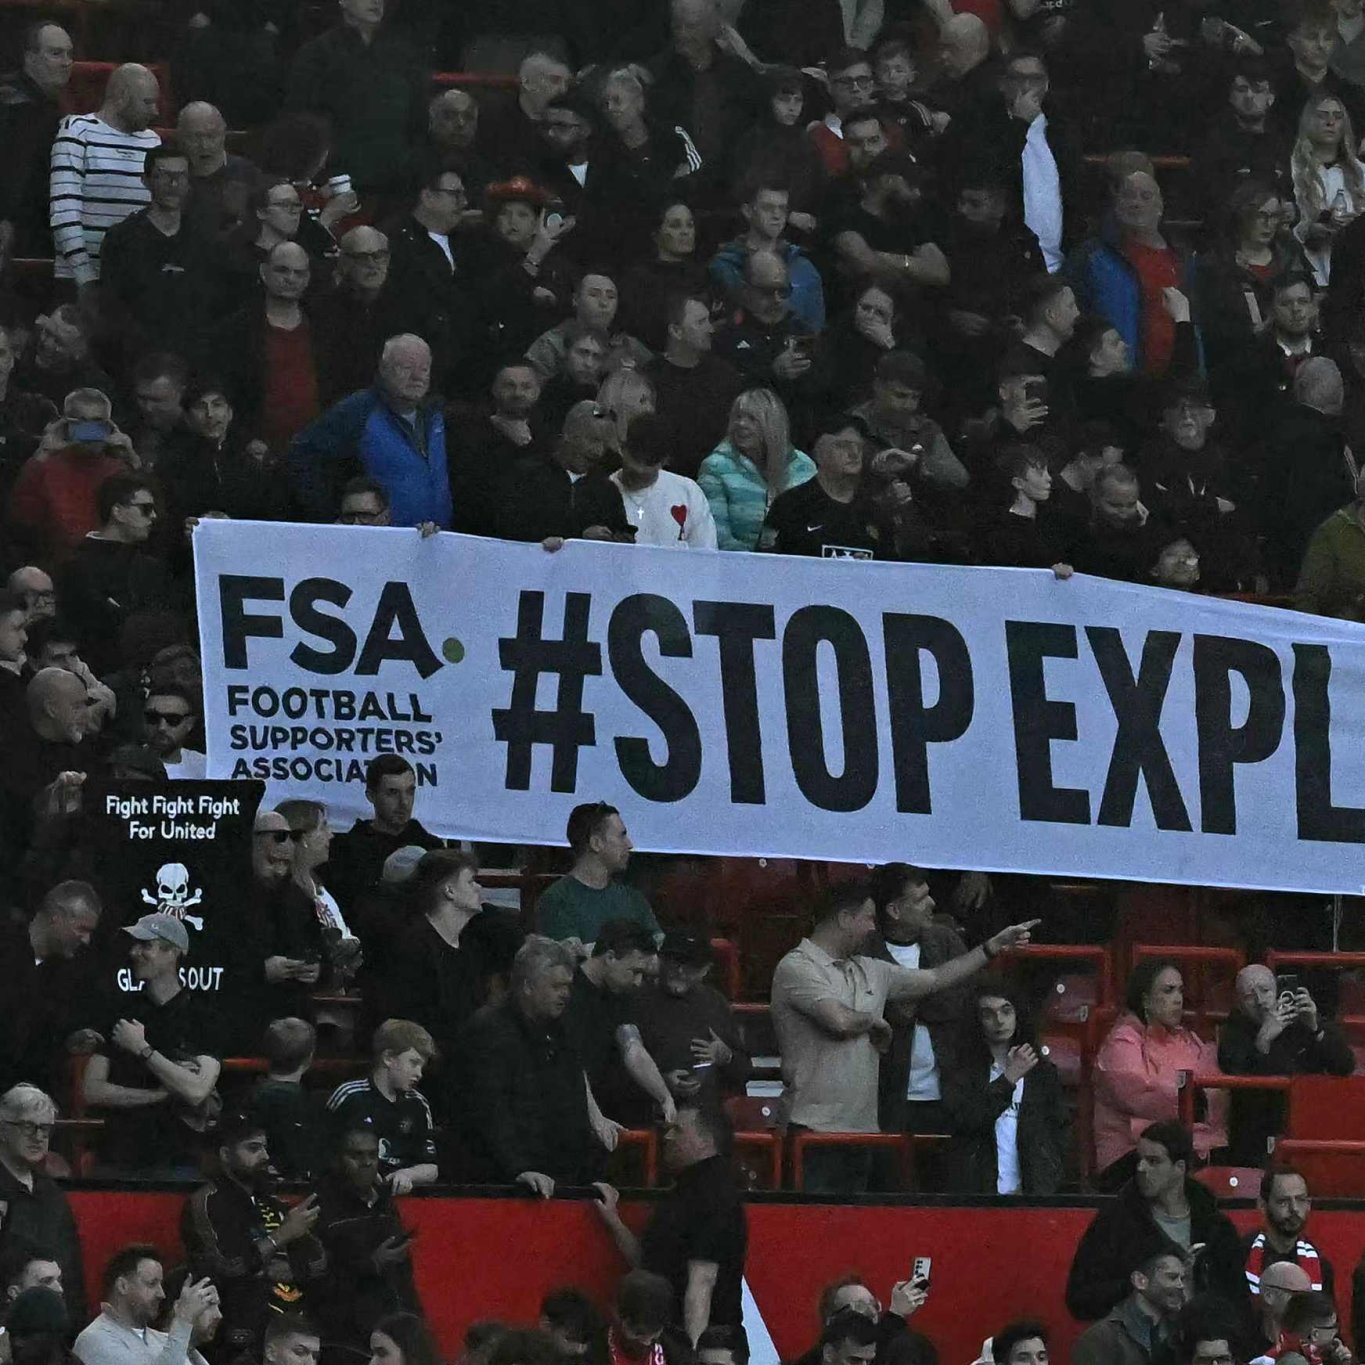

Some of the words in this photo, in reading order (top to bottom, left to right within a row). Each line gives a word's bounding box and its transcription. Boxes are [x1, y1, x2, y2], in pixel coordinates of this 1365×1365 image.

[227, 685, 433, 723] FOOTBALL
[491, 589, 975, 815] #STOP
[229, 724, 443, 755] SUPPORTERS'
[230, 756, 439, 787] ASSOCIAN
[106, 795, 149, 818] Fight
[152, 795, 195, 818] Fight
[198, 796, 240, 818] Fight
[129, 821, 156, 840] For
[160, 821, 216, 840] United
